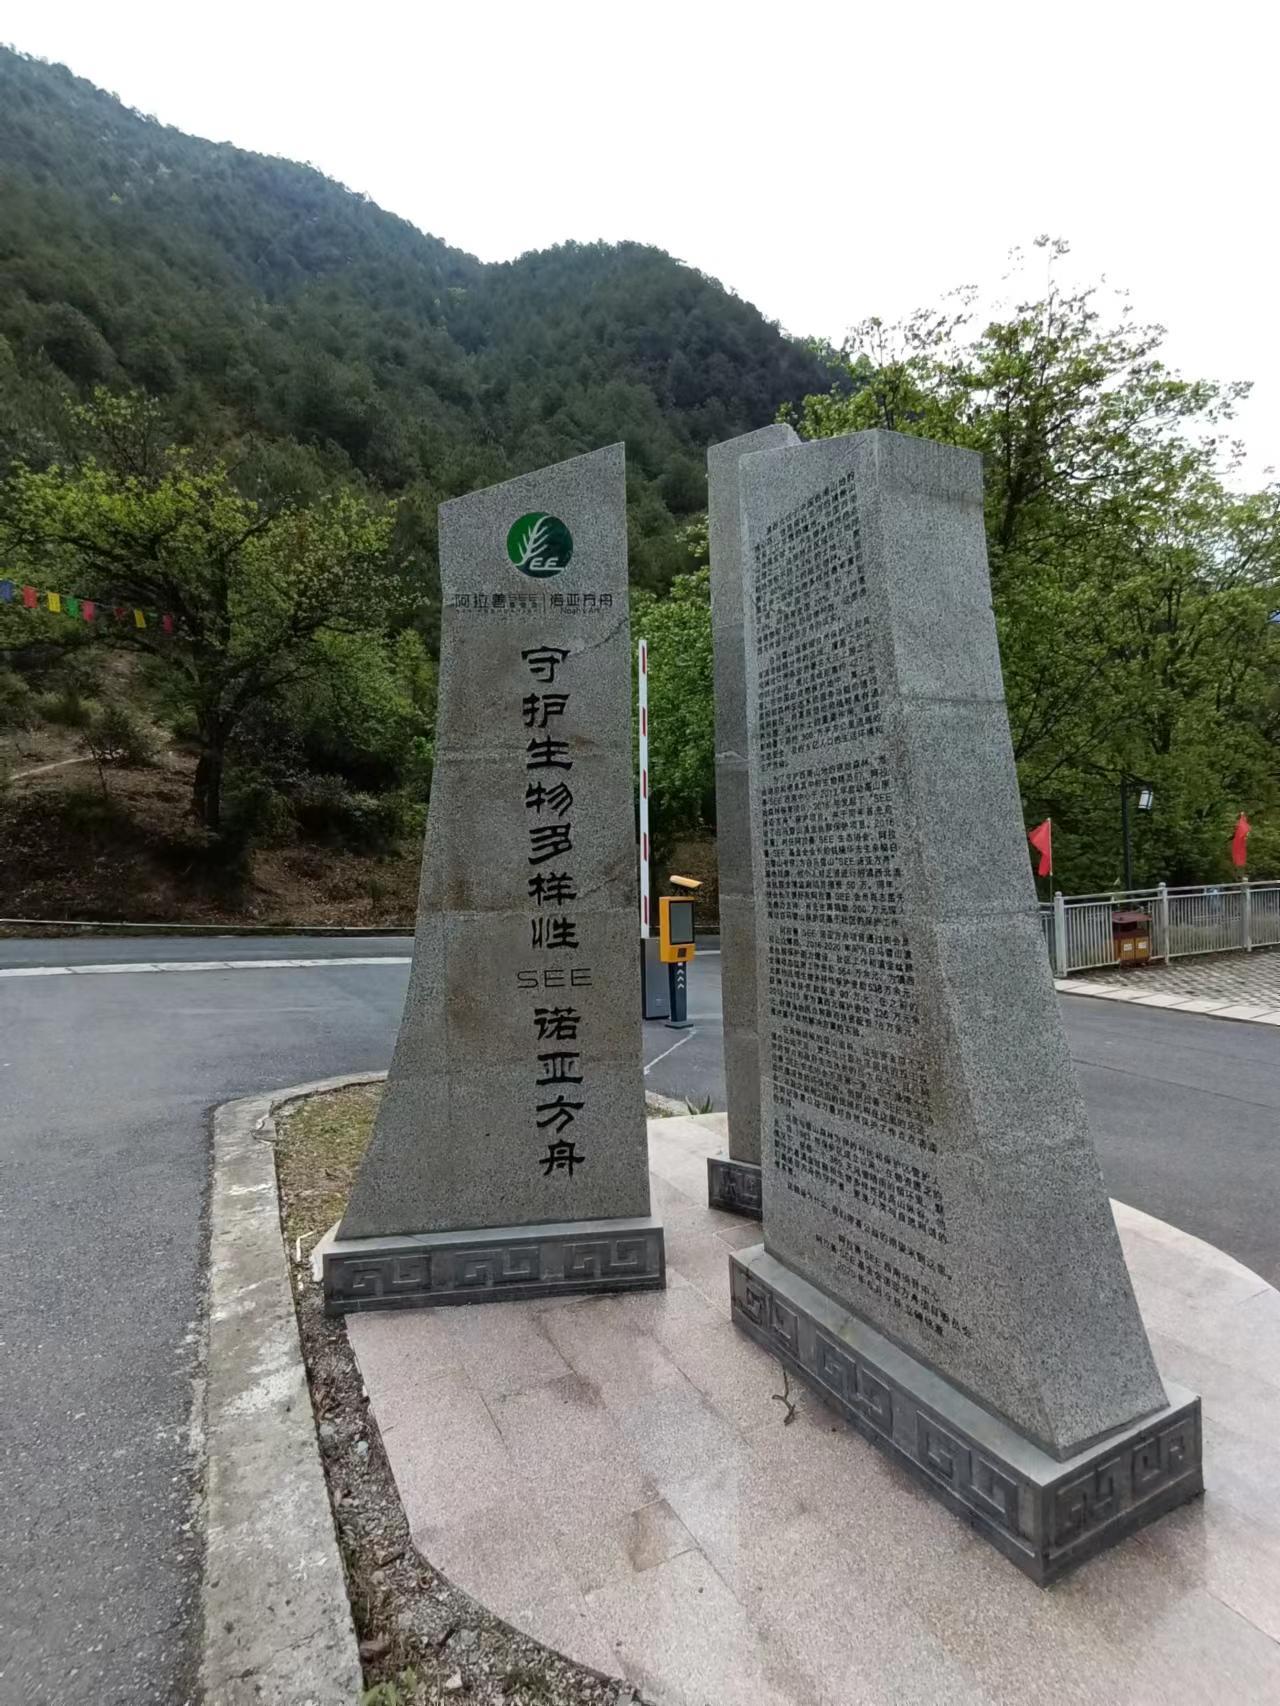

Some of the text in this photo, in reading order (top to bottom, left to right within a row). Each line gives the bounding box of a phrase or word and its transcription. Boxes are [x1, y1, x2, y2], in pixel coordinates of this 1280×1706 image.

[520, 645, 580, 950] 守护生物多样性
[516, 967, 593, 990] SEE
[533, 1006, 586, 1178] 诺亚方舟
